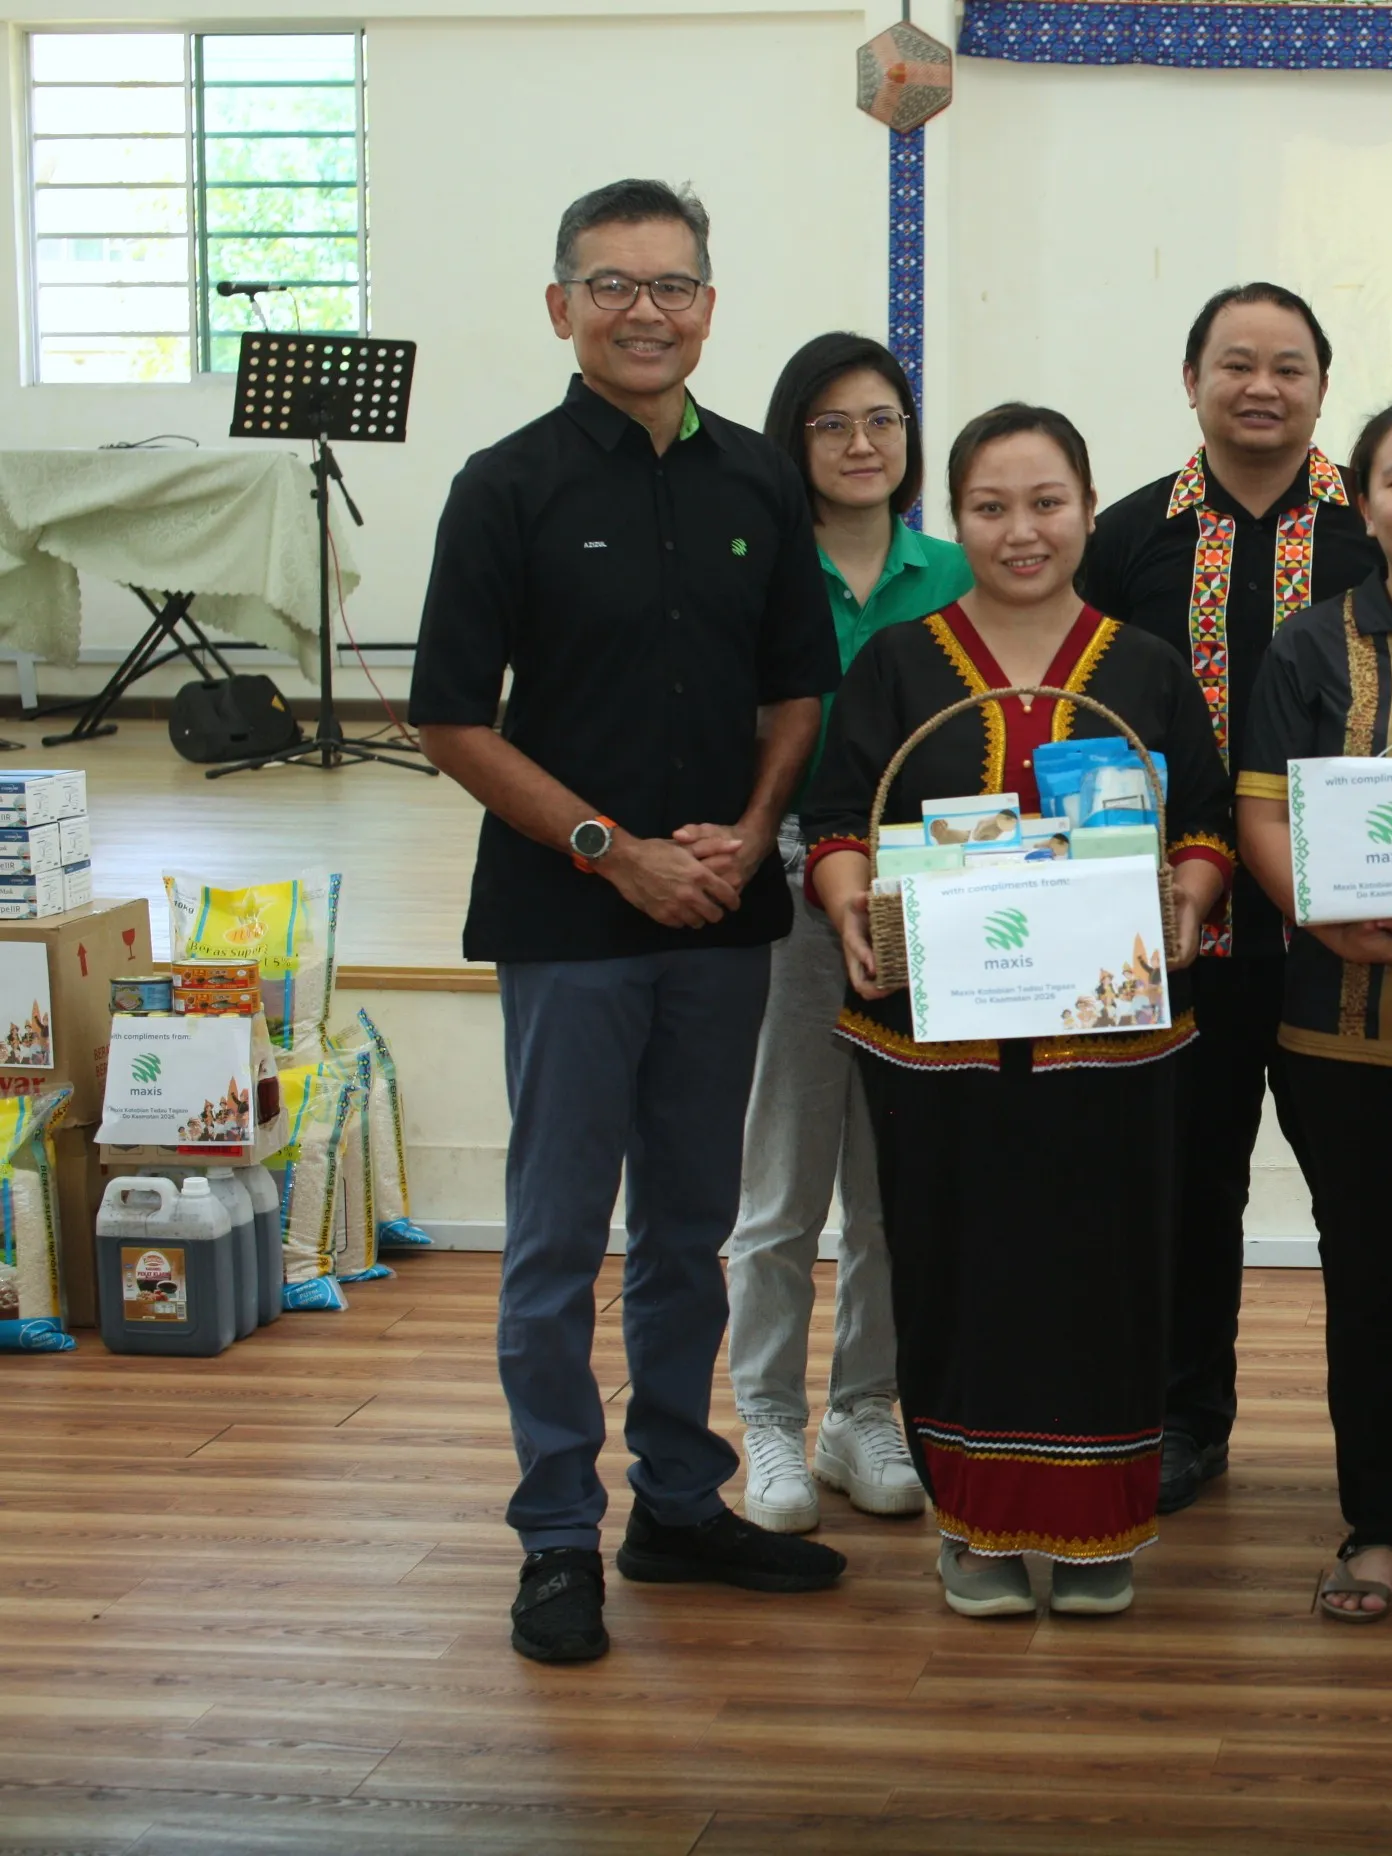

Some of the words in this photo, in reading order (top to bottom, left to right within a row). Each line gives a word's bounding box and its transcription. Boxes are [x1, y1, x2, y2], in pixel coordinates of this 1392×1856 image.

[1325, 776, 1348, 786] with
[941, 887, 965, 896] with
[968, 880, 1038, 893] compliments
[1041, 878, 1070, 887] from:
[1333, 883, 1357, 891] Maxis
[174, 900, 195, 915] 10kg
[984, 954, 1034, 970] maxis
[1034, 992, 1056, 1001] 2026
[124, 1033, 170, 1041] compliments
[130, 1087, 162, 1096] maxis
[328, 1151, 336, 1186] BERAS
[323, 1188, 333, 1223] SUPER
